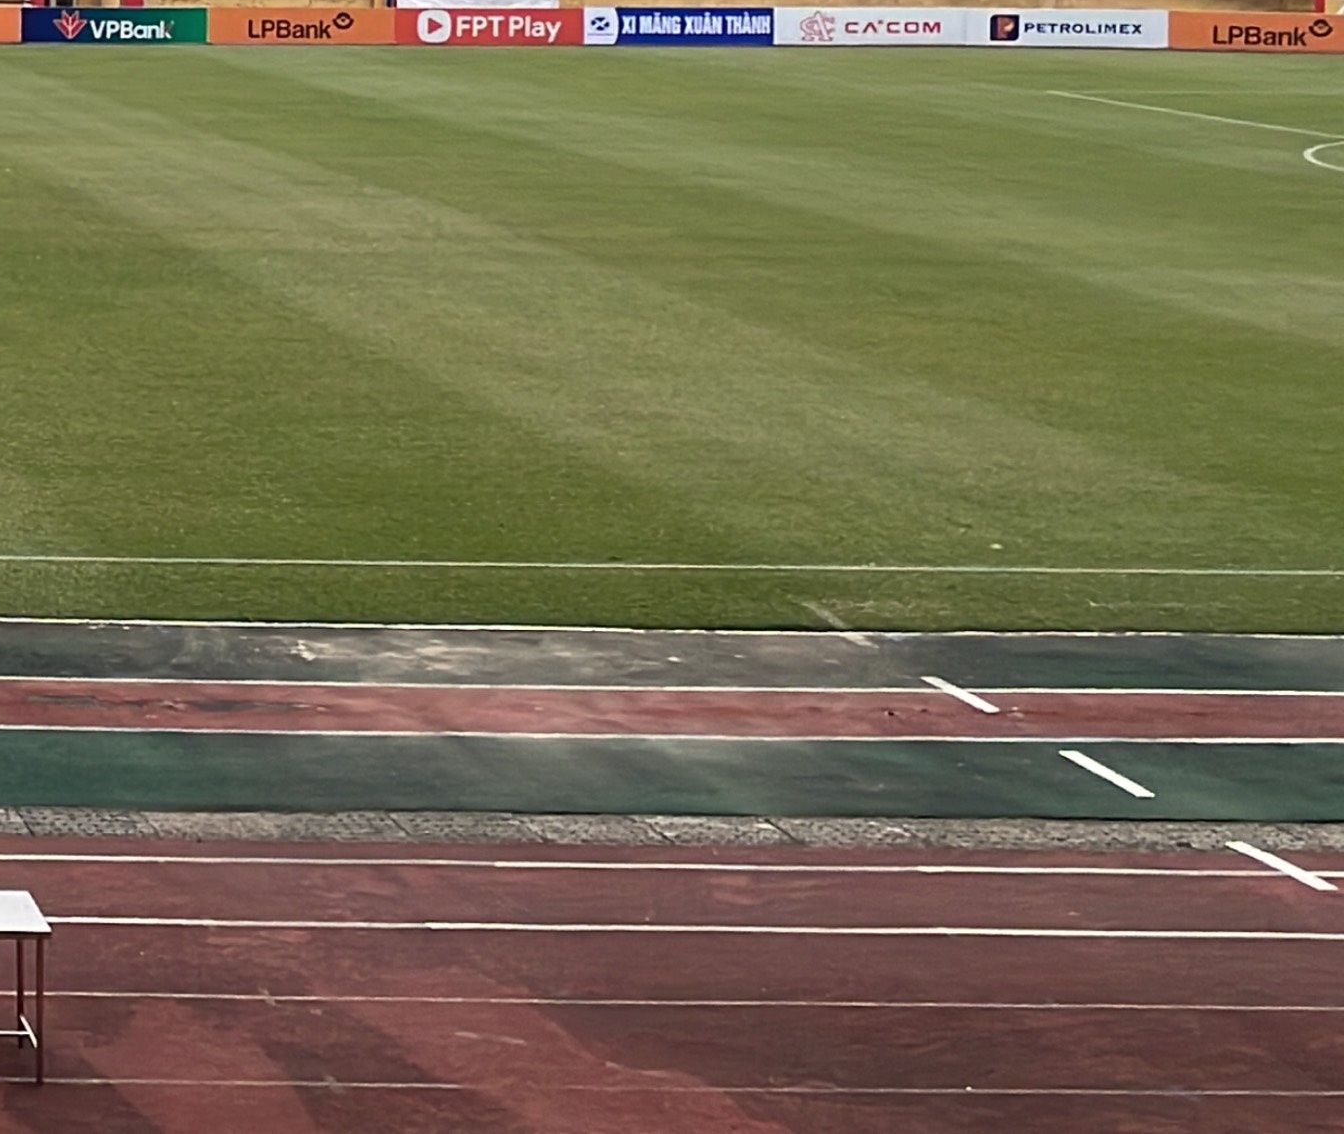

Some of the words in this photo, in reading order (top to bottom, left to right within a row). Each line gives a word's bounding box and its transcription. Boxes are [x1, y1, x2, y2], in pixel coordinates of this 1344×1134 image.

[89, 20, 172, 39] VPBank
[248, 19, 331, 38] LPBank
[456, 16, 505, 37] FPT
[508, 16, 561, 42] Play
[621, 15, 635, 34] XI
[1025, 23, 1142, 34] PETROLIMEX
[1213, 25, 1307, 45] LPBank
